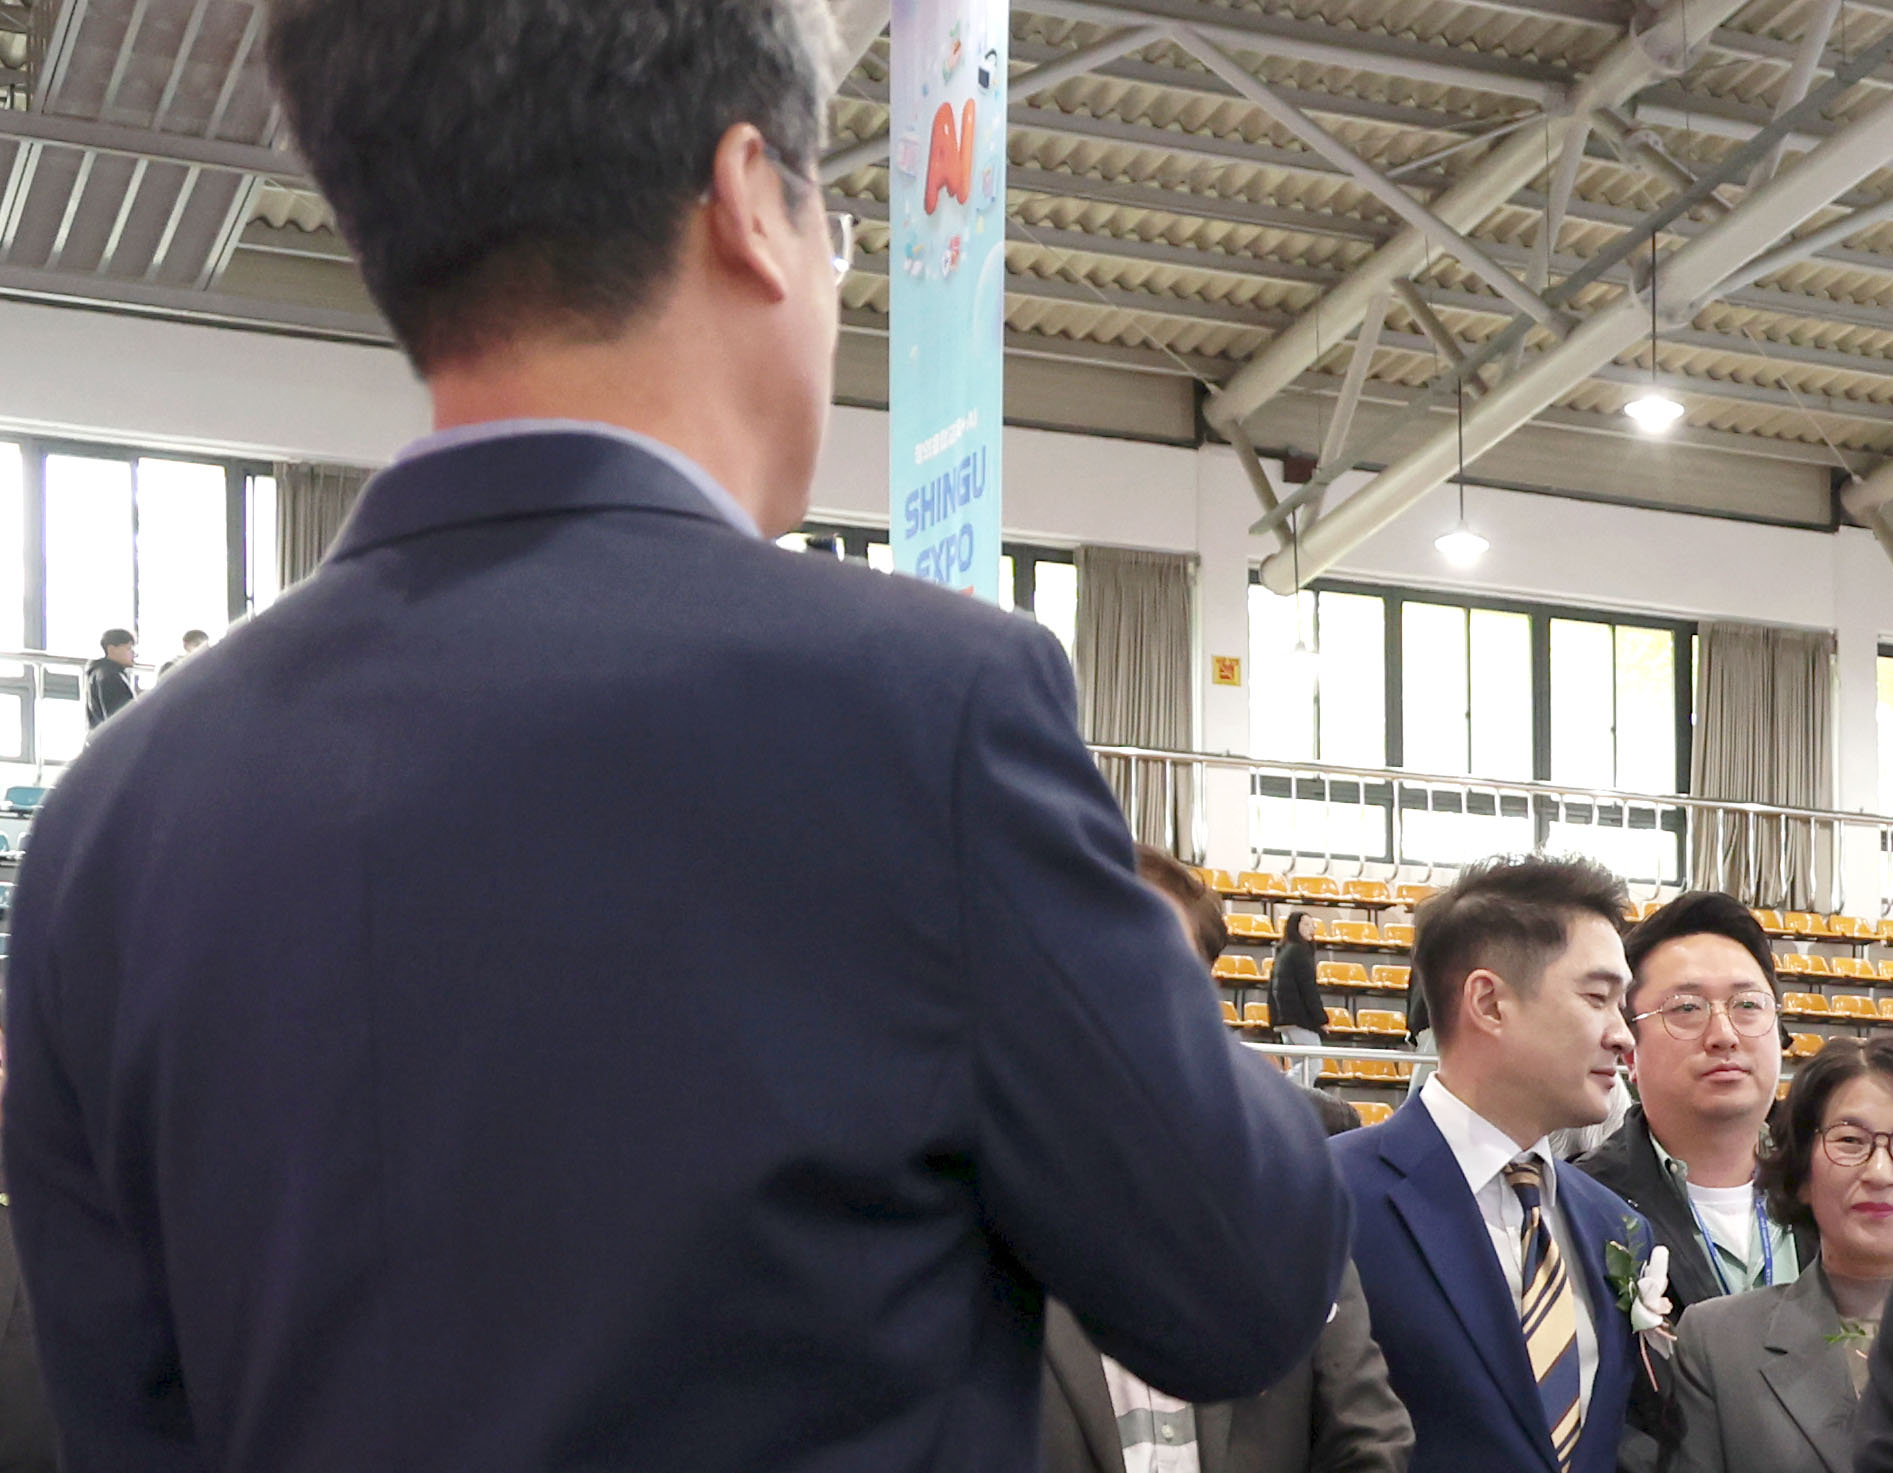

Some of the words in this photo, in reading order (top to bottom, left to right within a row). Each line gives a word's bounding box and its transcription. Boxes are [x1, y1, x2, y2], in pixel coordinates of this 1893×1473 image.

[924, 98, 975, 215] AI
[904, 444, 987, 540] SHINGU
[915, 522, 974, 585] EXPO
